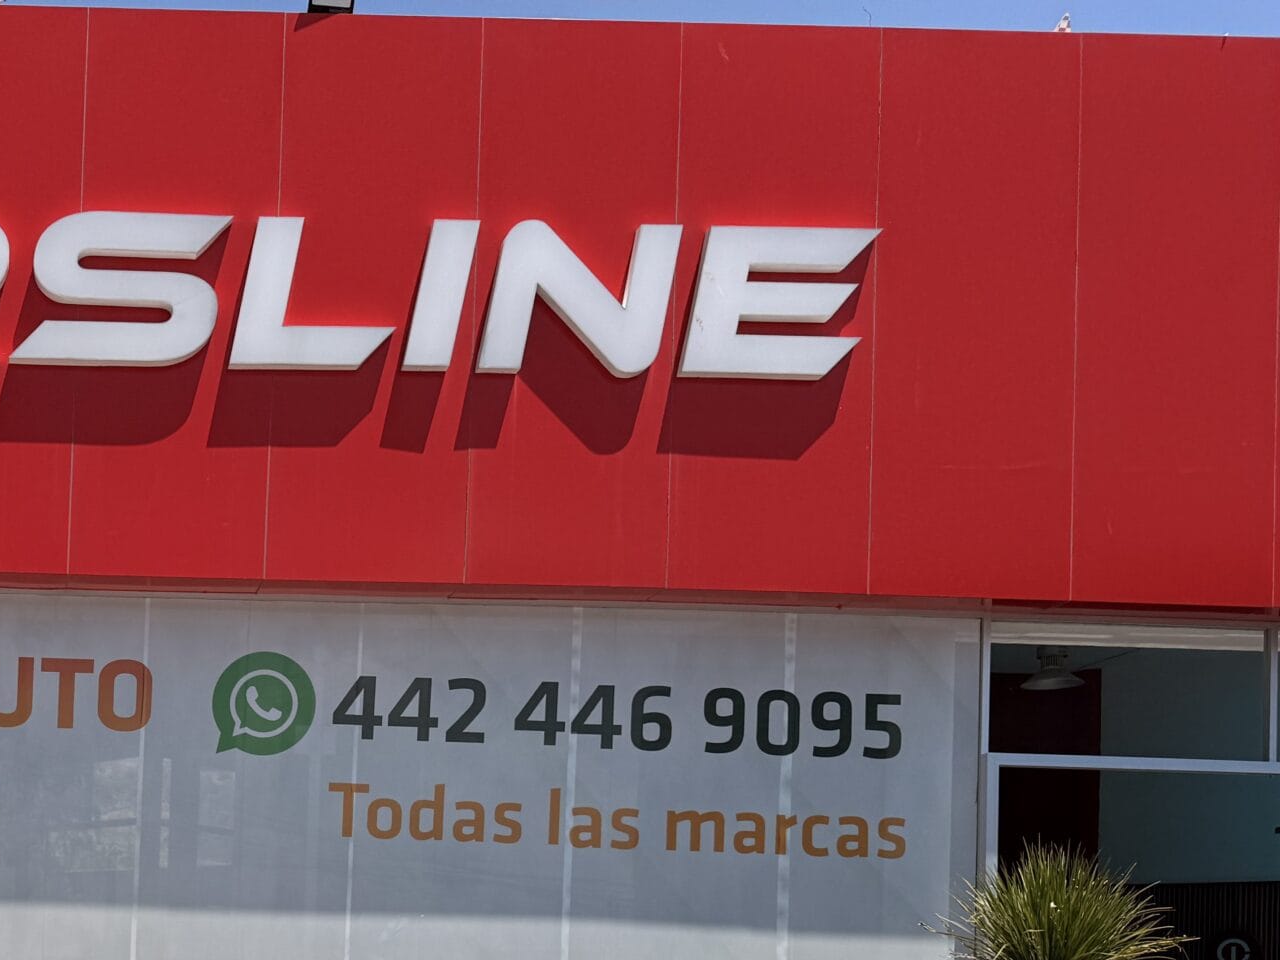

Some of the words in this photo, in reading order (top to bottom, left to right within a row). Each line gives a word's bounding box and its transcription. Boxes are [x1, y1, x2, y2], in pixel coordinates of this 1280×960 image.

[331, 675, 488, 744] 442
[513, 681, 673, 752] 446
[702, 686, 903, 760] 9095
[328, 782, 522, 845] Todas
[547, 787, 640, 851] las
[664, 808, 908, 861] marcas
